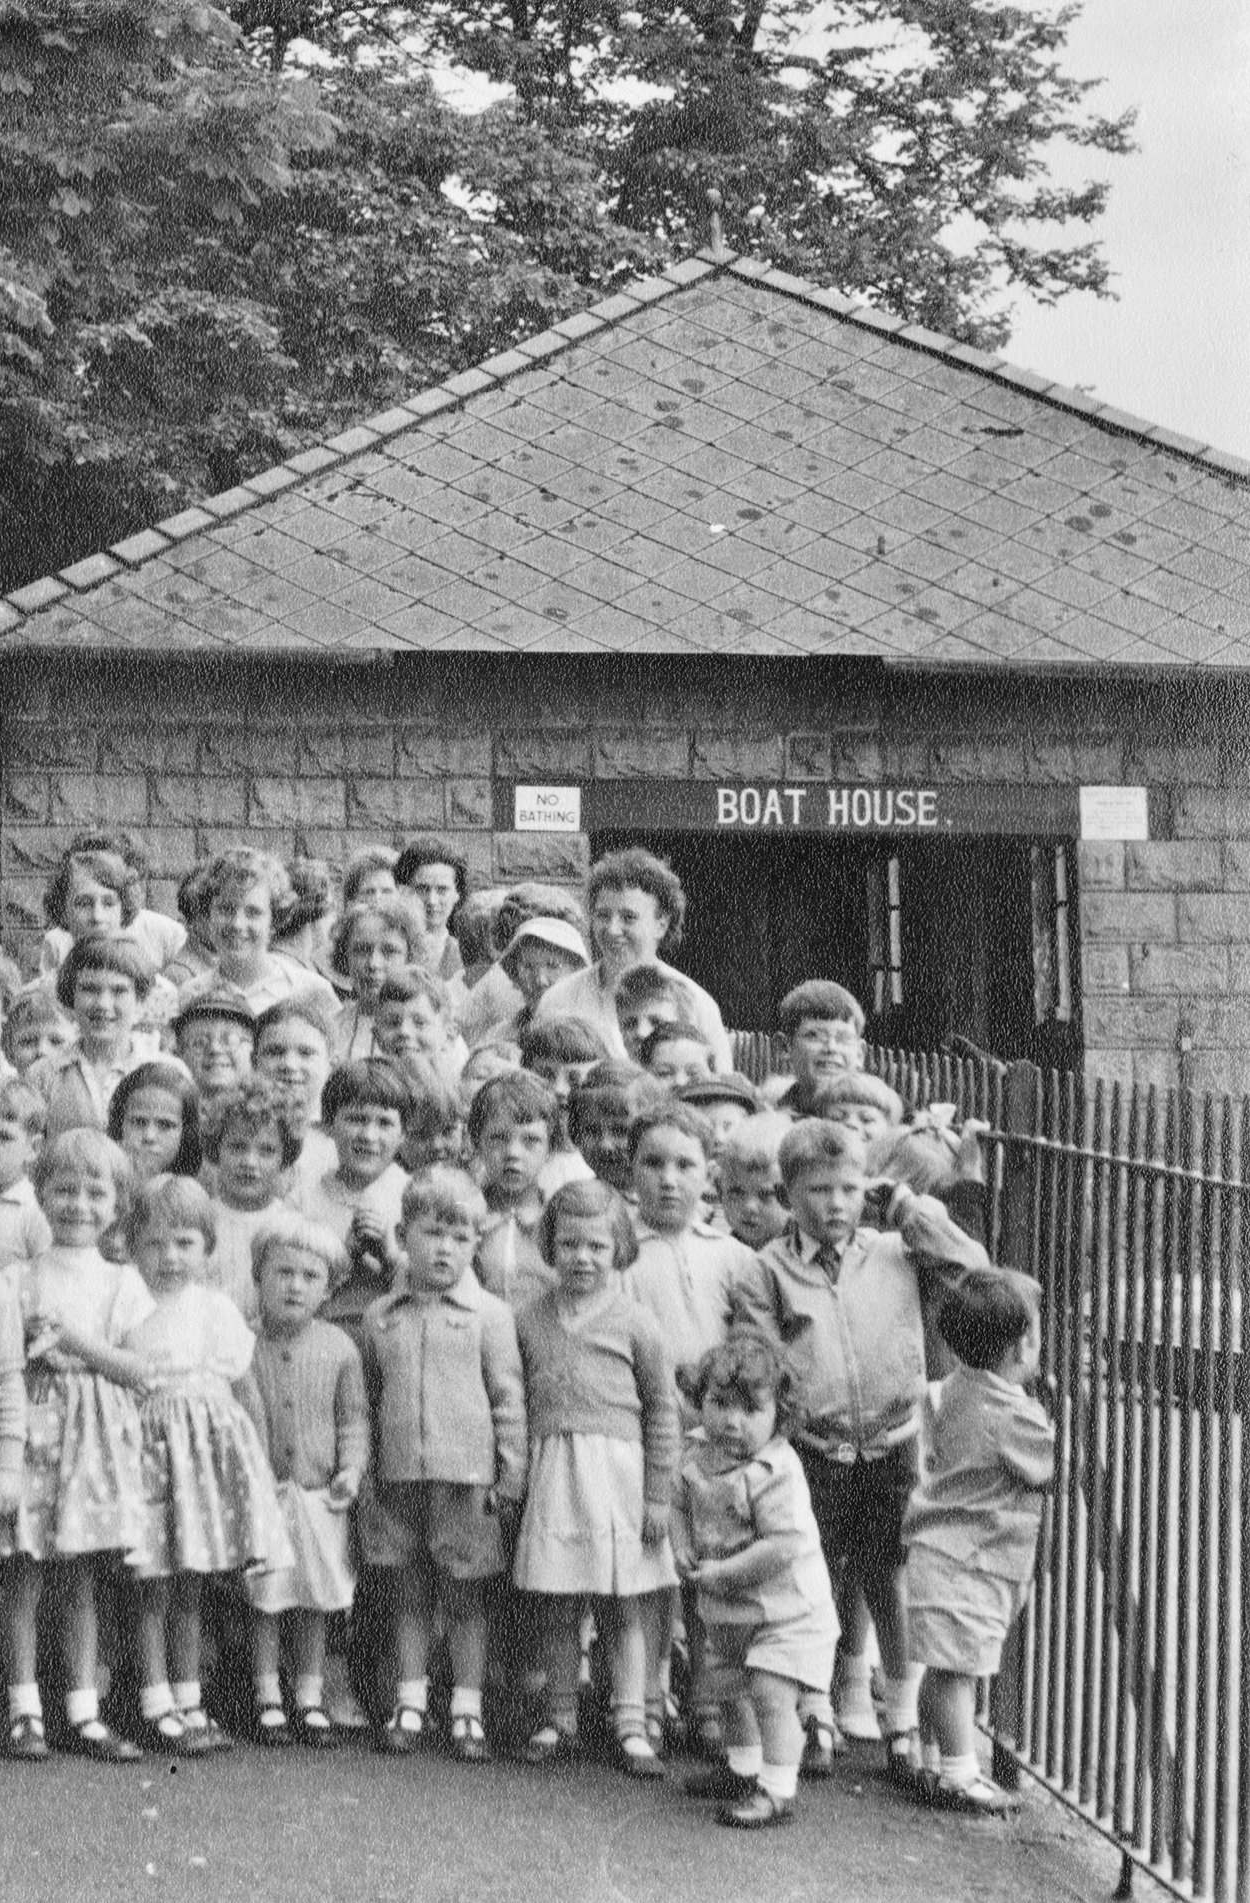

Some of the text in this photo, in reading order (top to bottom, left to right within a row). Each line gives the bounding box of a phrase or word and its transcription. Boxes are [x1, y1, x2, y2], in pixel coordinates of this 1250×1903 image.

[536, 793, 559, 806] NO
[717, 788, 807, 825] BOAT
[519, 810, 575, 823] BATHING
